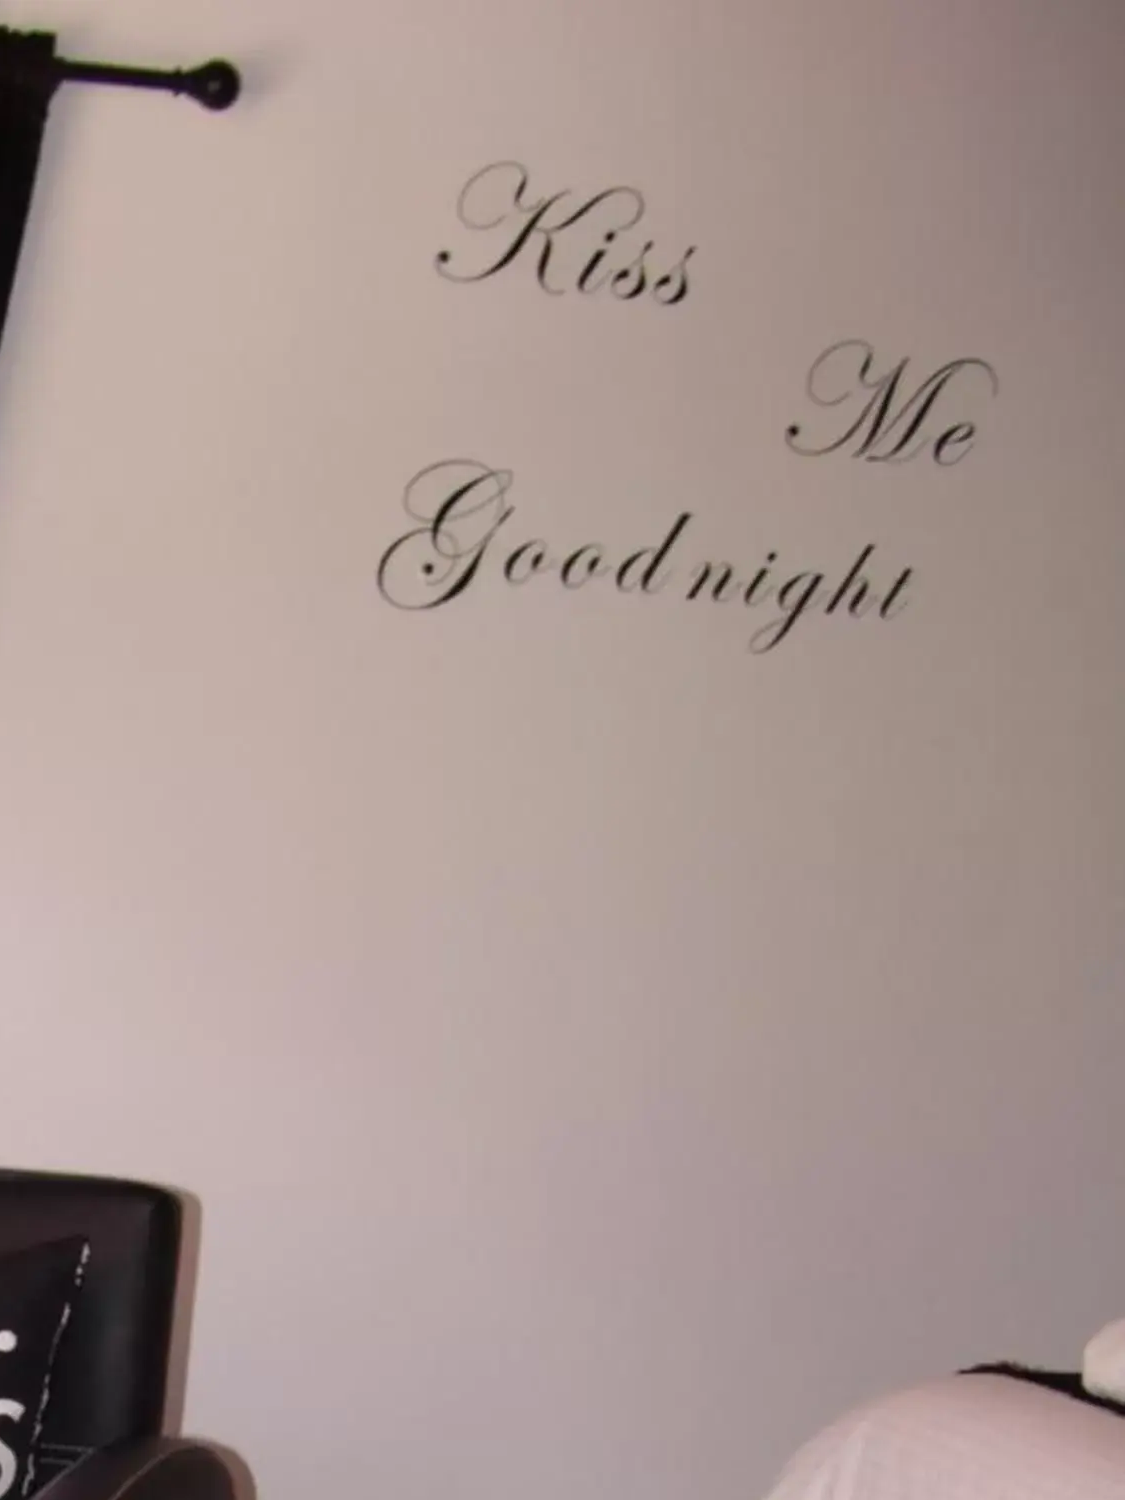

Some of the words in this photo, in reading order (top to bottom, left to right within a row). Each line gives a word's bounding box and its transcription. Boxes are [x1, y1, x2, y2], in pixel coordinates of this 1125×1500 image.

[435, 160, 697, 306] Kiss
[785, 338, 999, 466] Me
[377, 457, 913, 655] Goodnight
